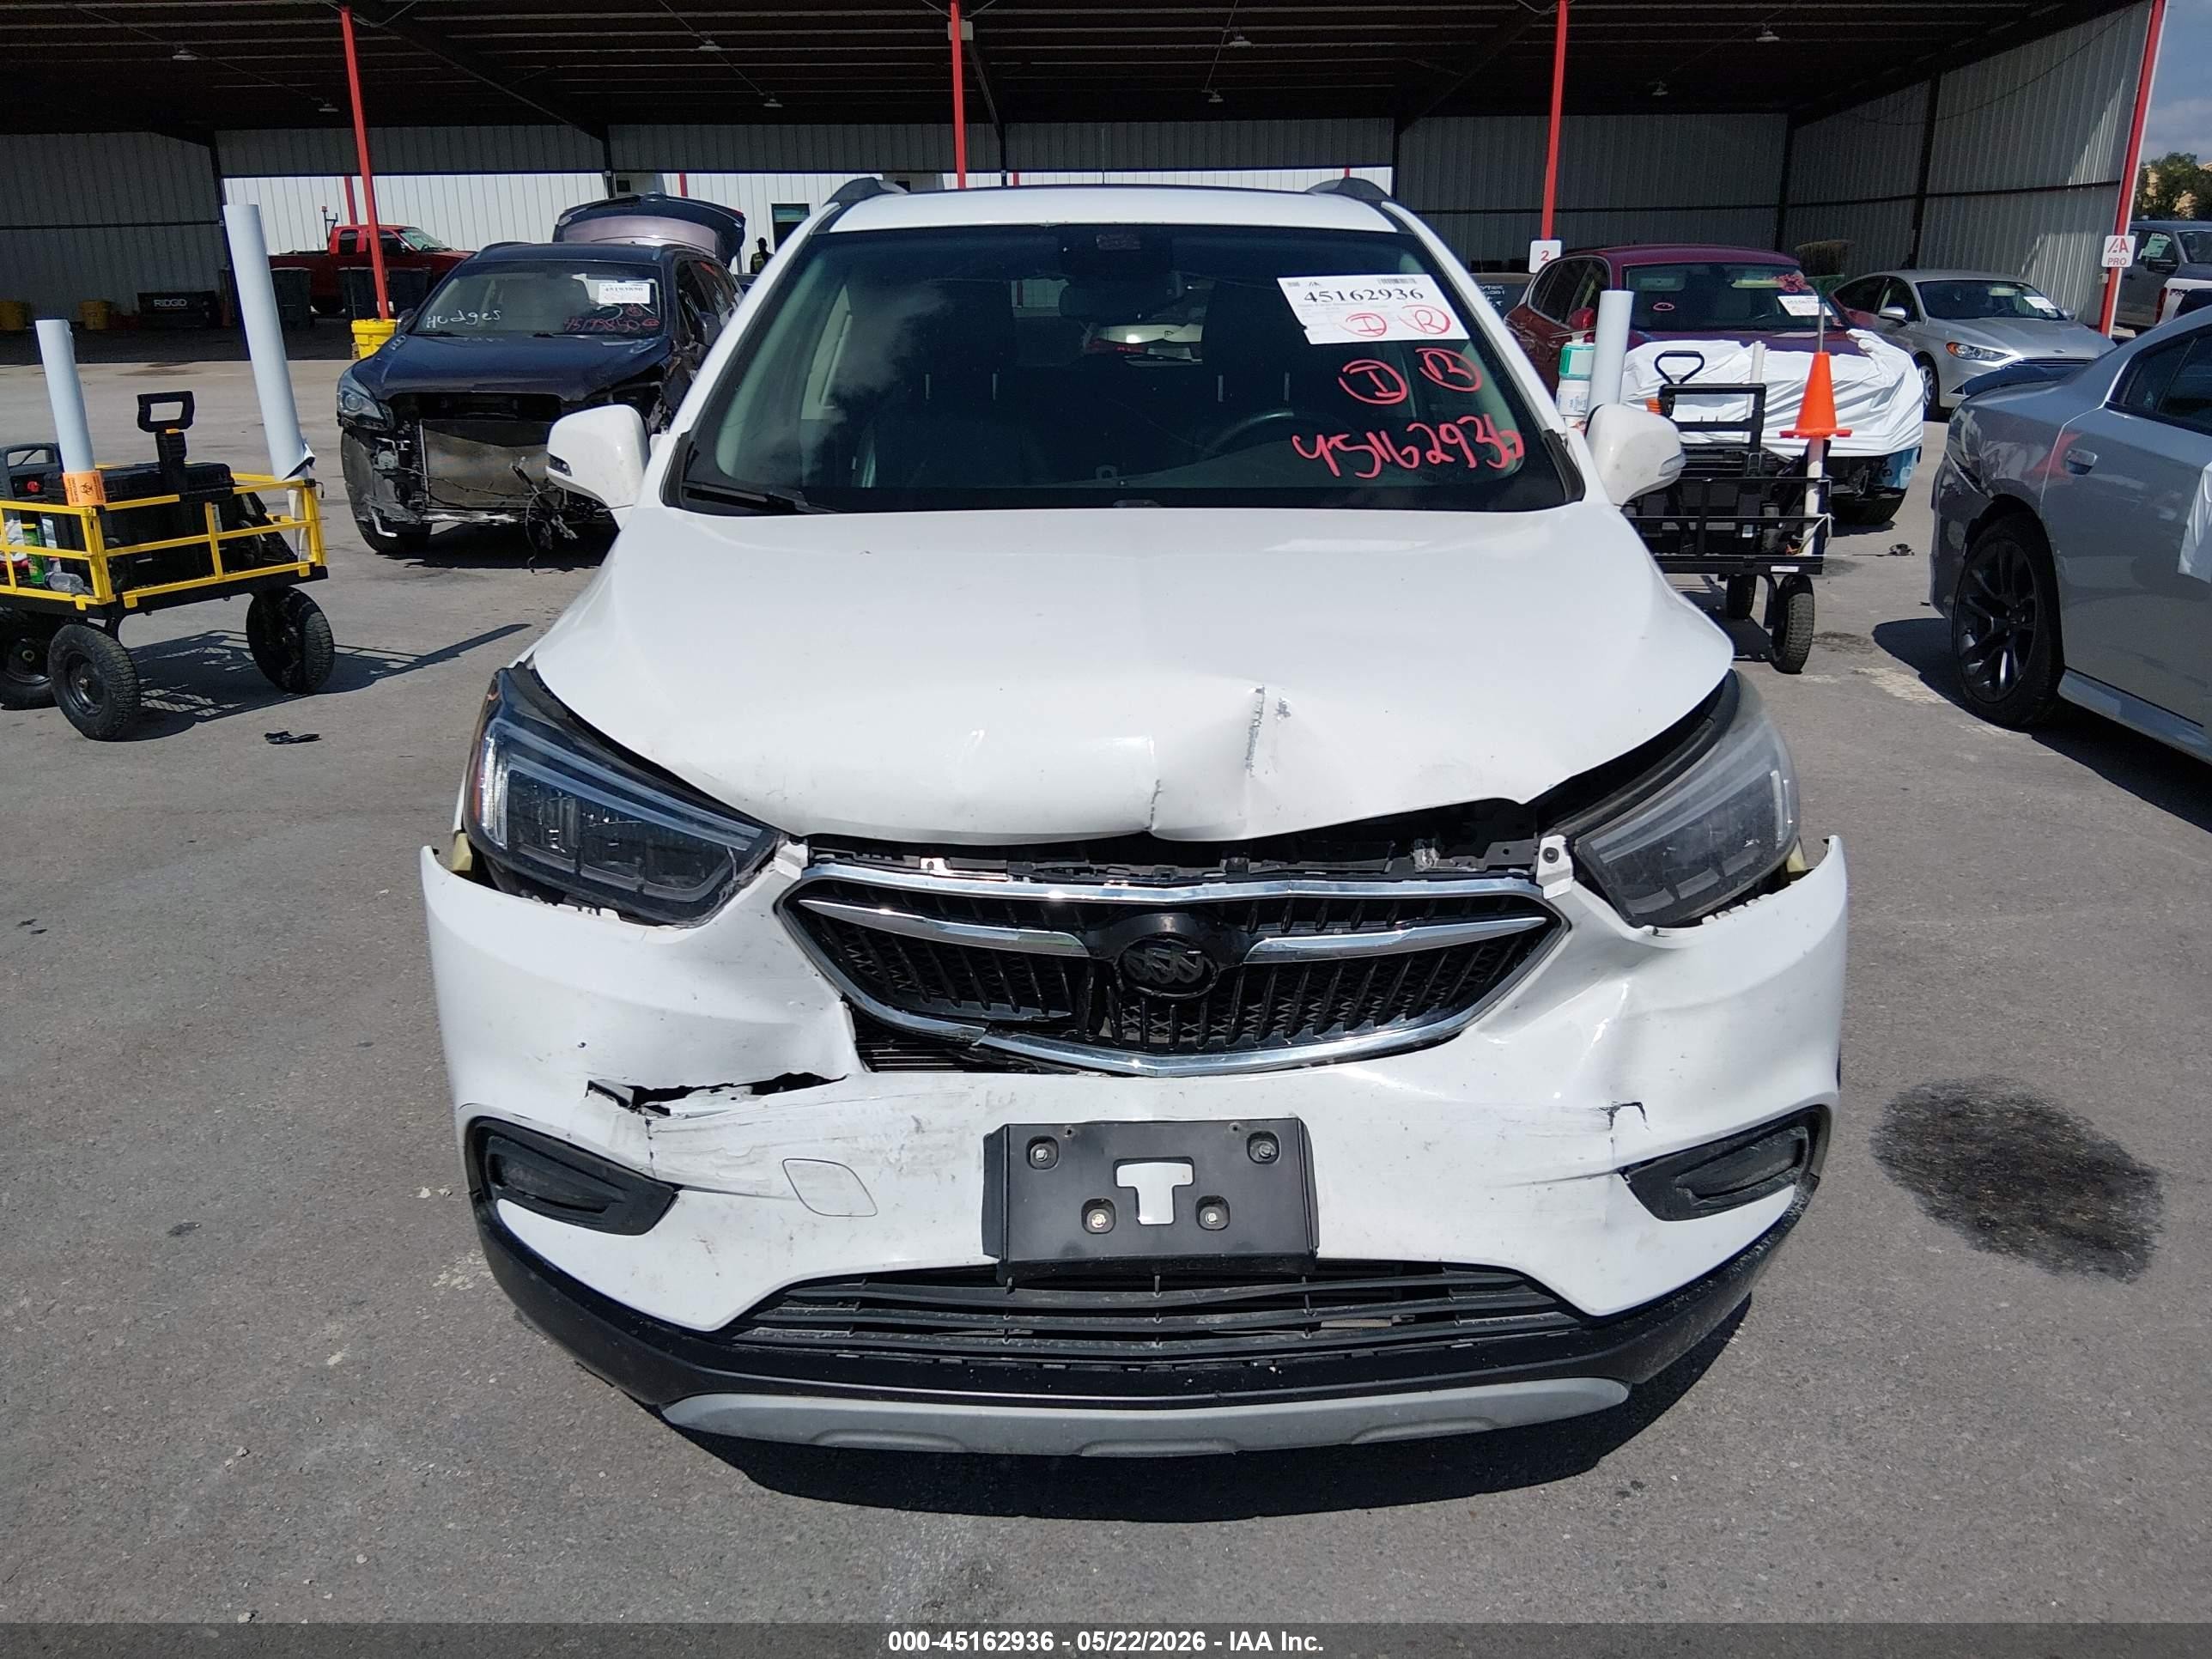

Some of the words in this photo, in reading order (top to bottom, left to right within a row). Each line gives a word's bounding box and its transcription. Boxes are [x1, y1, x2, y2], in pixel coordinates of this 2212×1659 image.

[1540, 250, 1550, 262] 2
[2107, 258, 2127, 266] PRO
[1304, 288, 1425, 303] 45162936
[153, 298, 188, 307] RIDGID
[1291, 413, 1524, 478] 45162936
